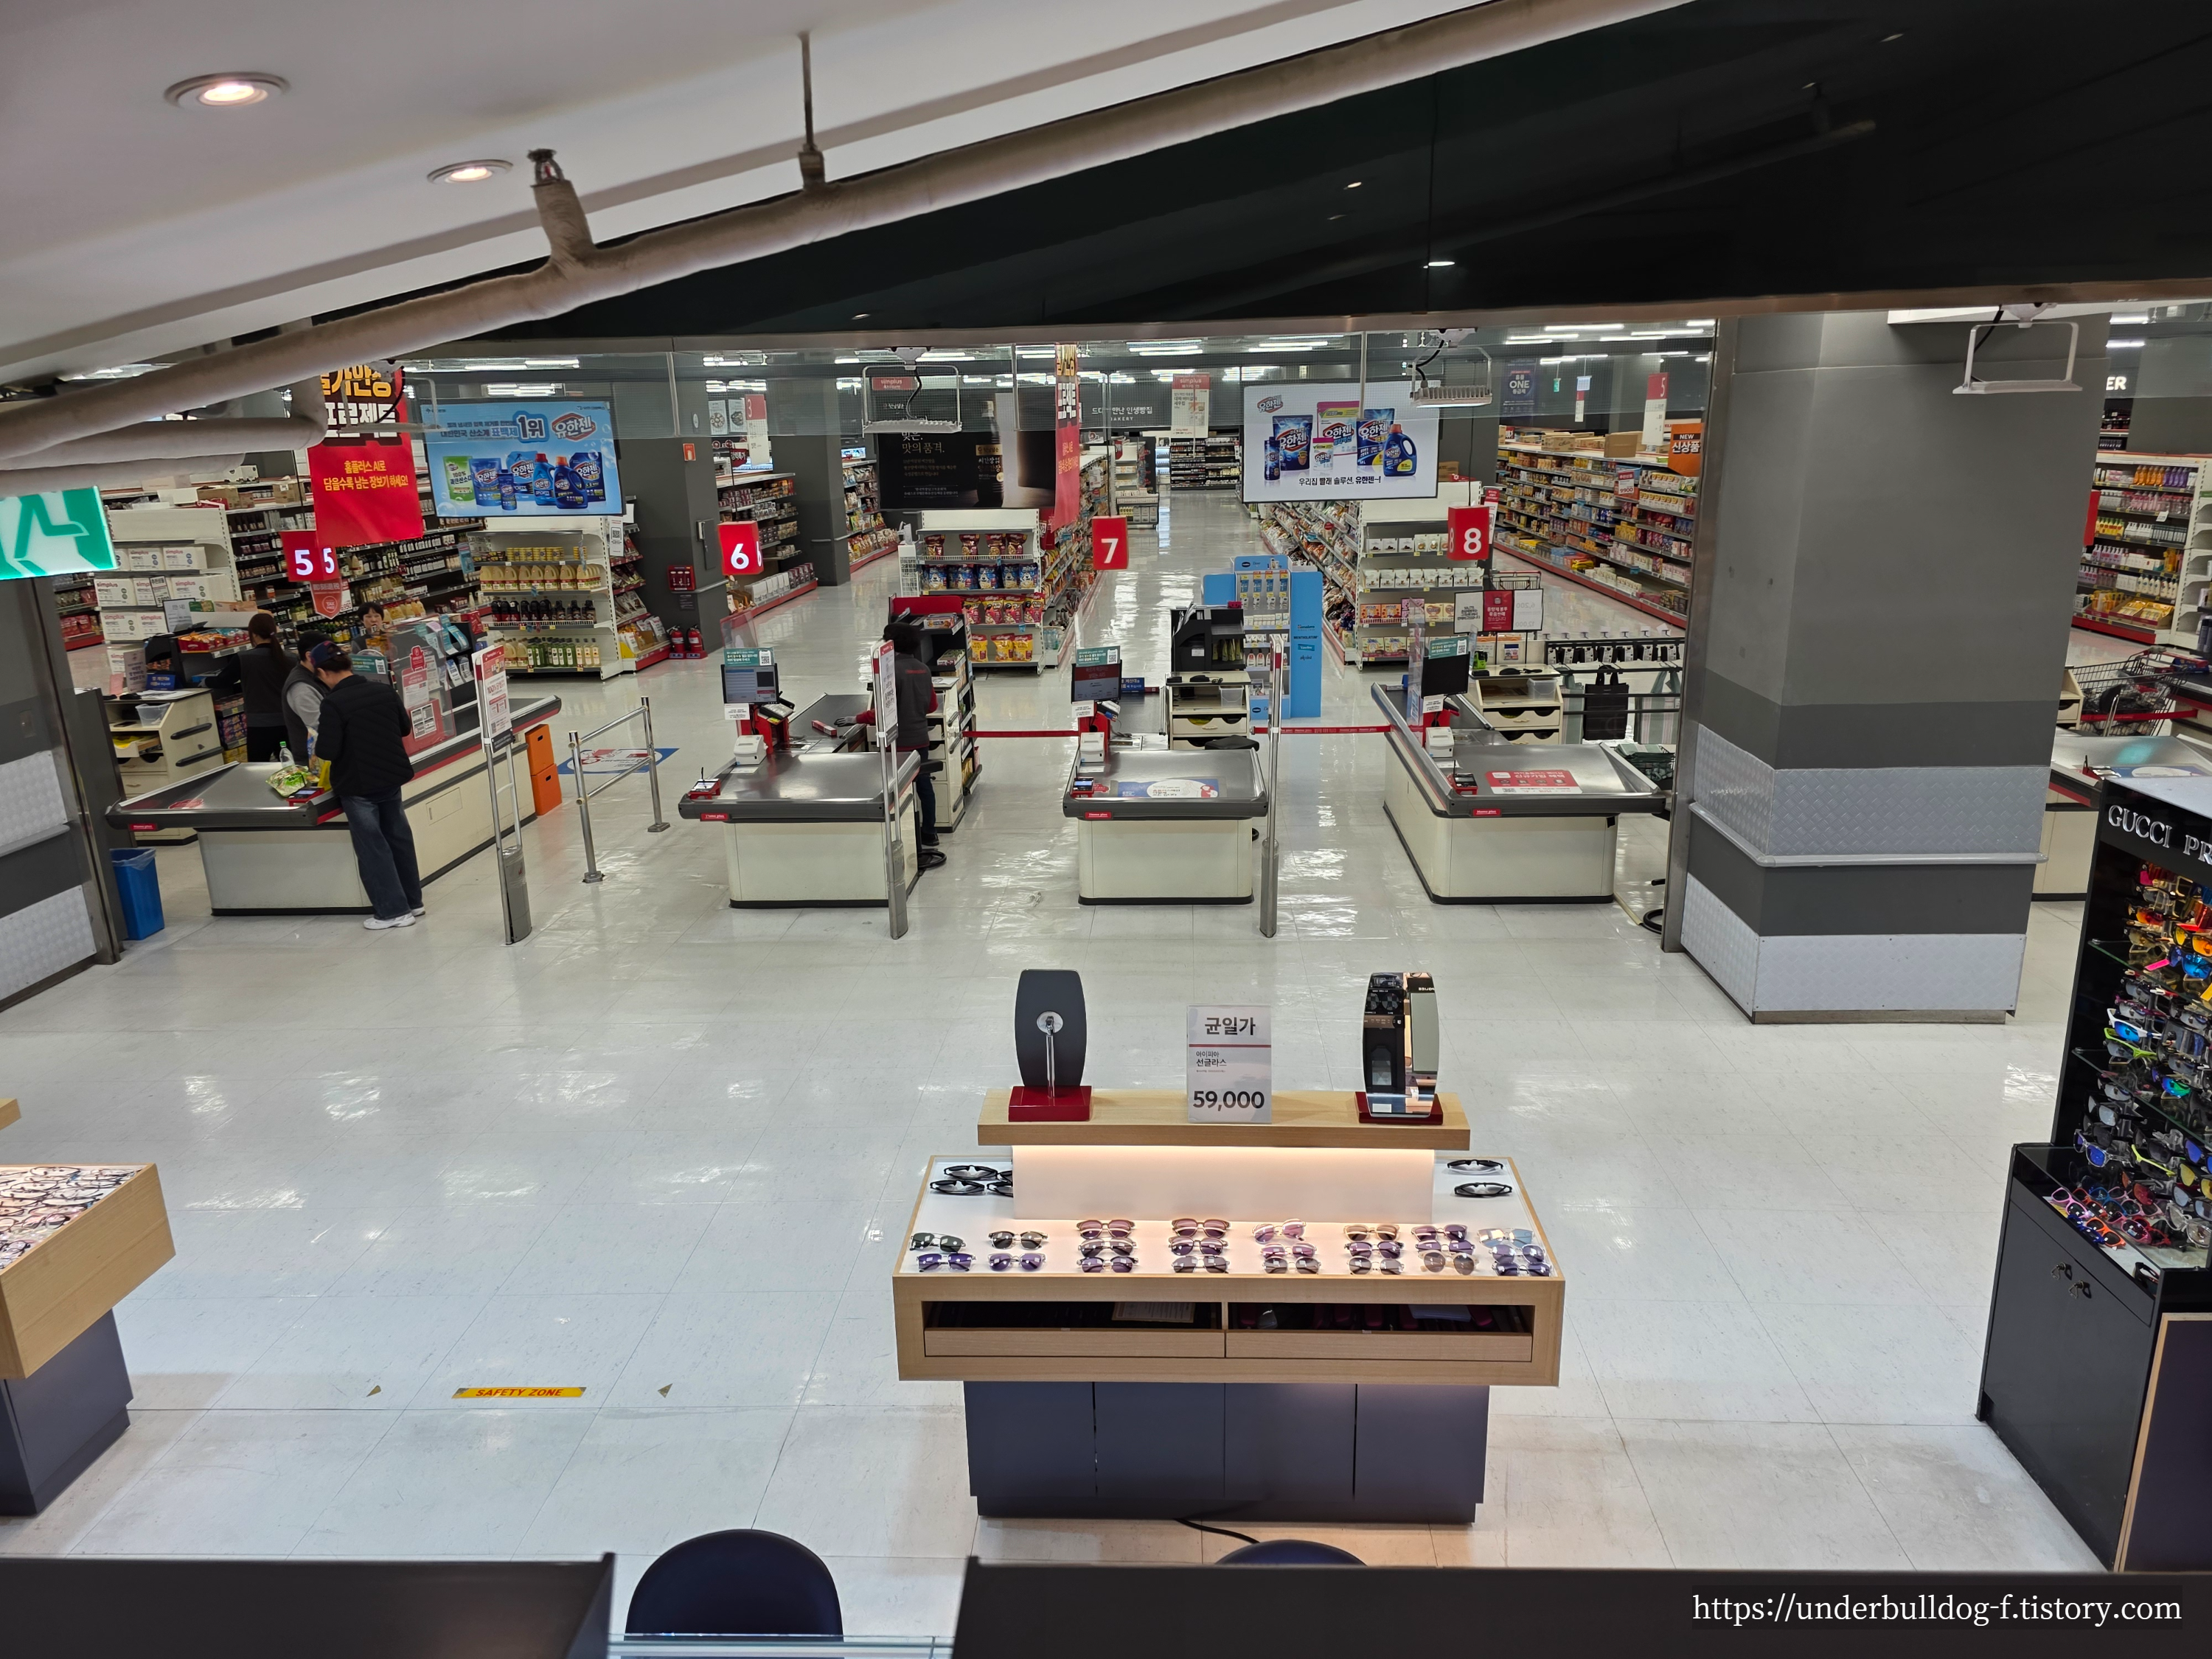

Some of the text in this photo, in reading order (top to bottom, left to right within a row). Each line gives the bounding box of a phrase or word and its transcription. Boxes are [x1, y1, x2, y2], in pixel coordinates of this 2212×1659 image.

[1509, 380, 1530, 389] ONE
[1660, 378, 1666, 397] 5
[2106, 376, 2126, 391] ER
[1126, 406, 1152, 414] 인생빵집
[1258, 396, 1281, 413] 유한젠
[518, 416, 544, 439] 1위
[555, 415, 592, 439] 유한젠
[902, 442, 945, 454] 맛의 품격.
[1672, 442, 1700, 453] 신상품
[344, 460, 386, 473] 홈플러스 AI로
[324, 477, 354, 491] 담을수록
[355, 477, 369, 490] 남는
[369, 476, 389, 488] 장보기
[1298, 478, 1318, 486] 우리집
[1319, 477, 1332, 485] 빨래
[1463, 528, 1481, 554] 8
[731, 543, 749, 569] 6
[1102, 538, 1118, 563] 7
[295, 549, 313, 575] 5
[323, 548, 335, 574] 5
[2108, 804, 2172, 848] GUCCI
[1205, 1017, 1256, 1035] 균일가
[1196, 1059, 1227, 1067] 선글라스
[1192, 1091, 1265, 1111] 59,000
[476, 1388, 563, 1397] SAFETY ZONE
